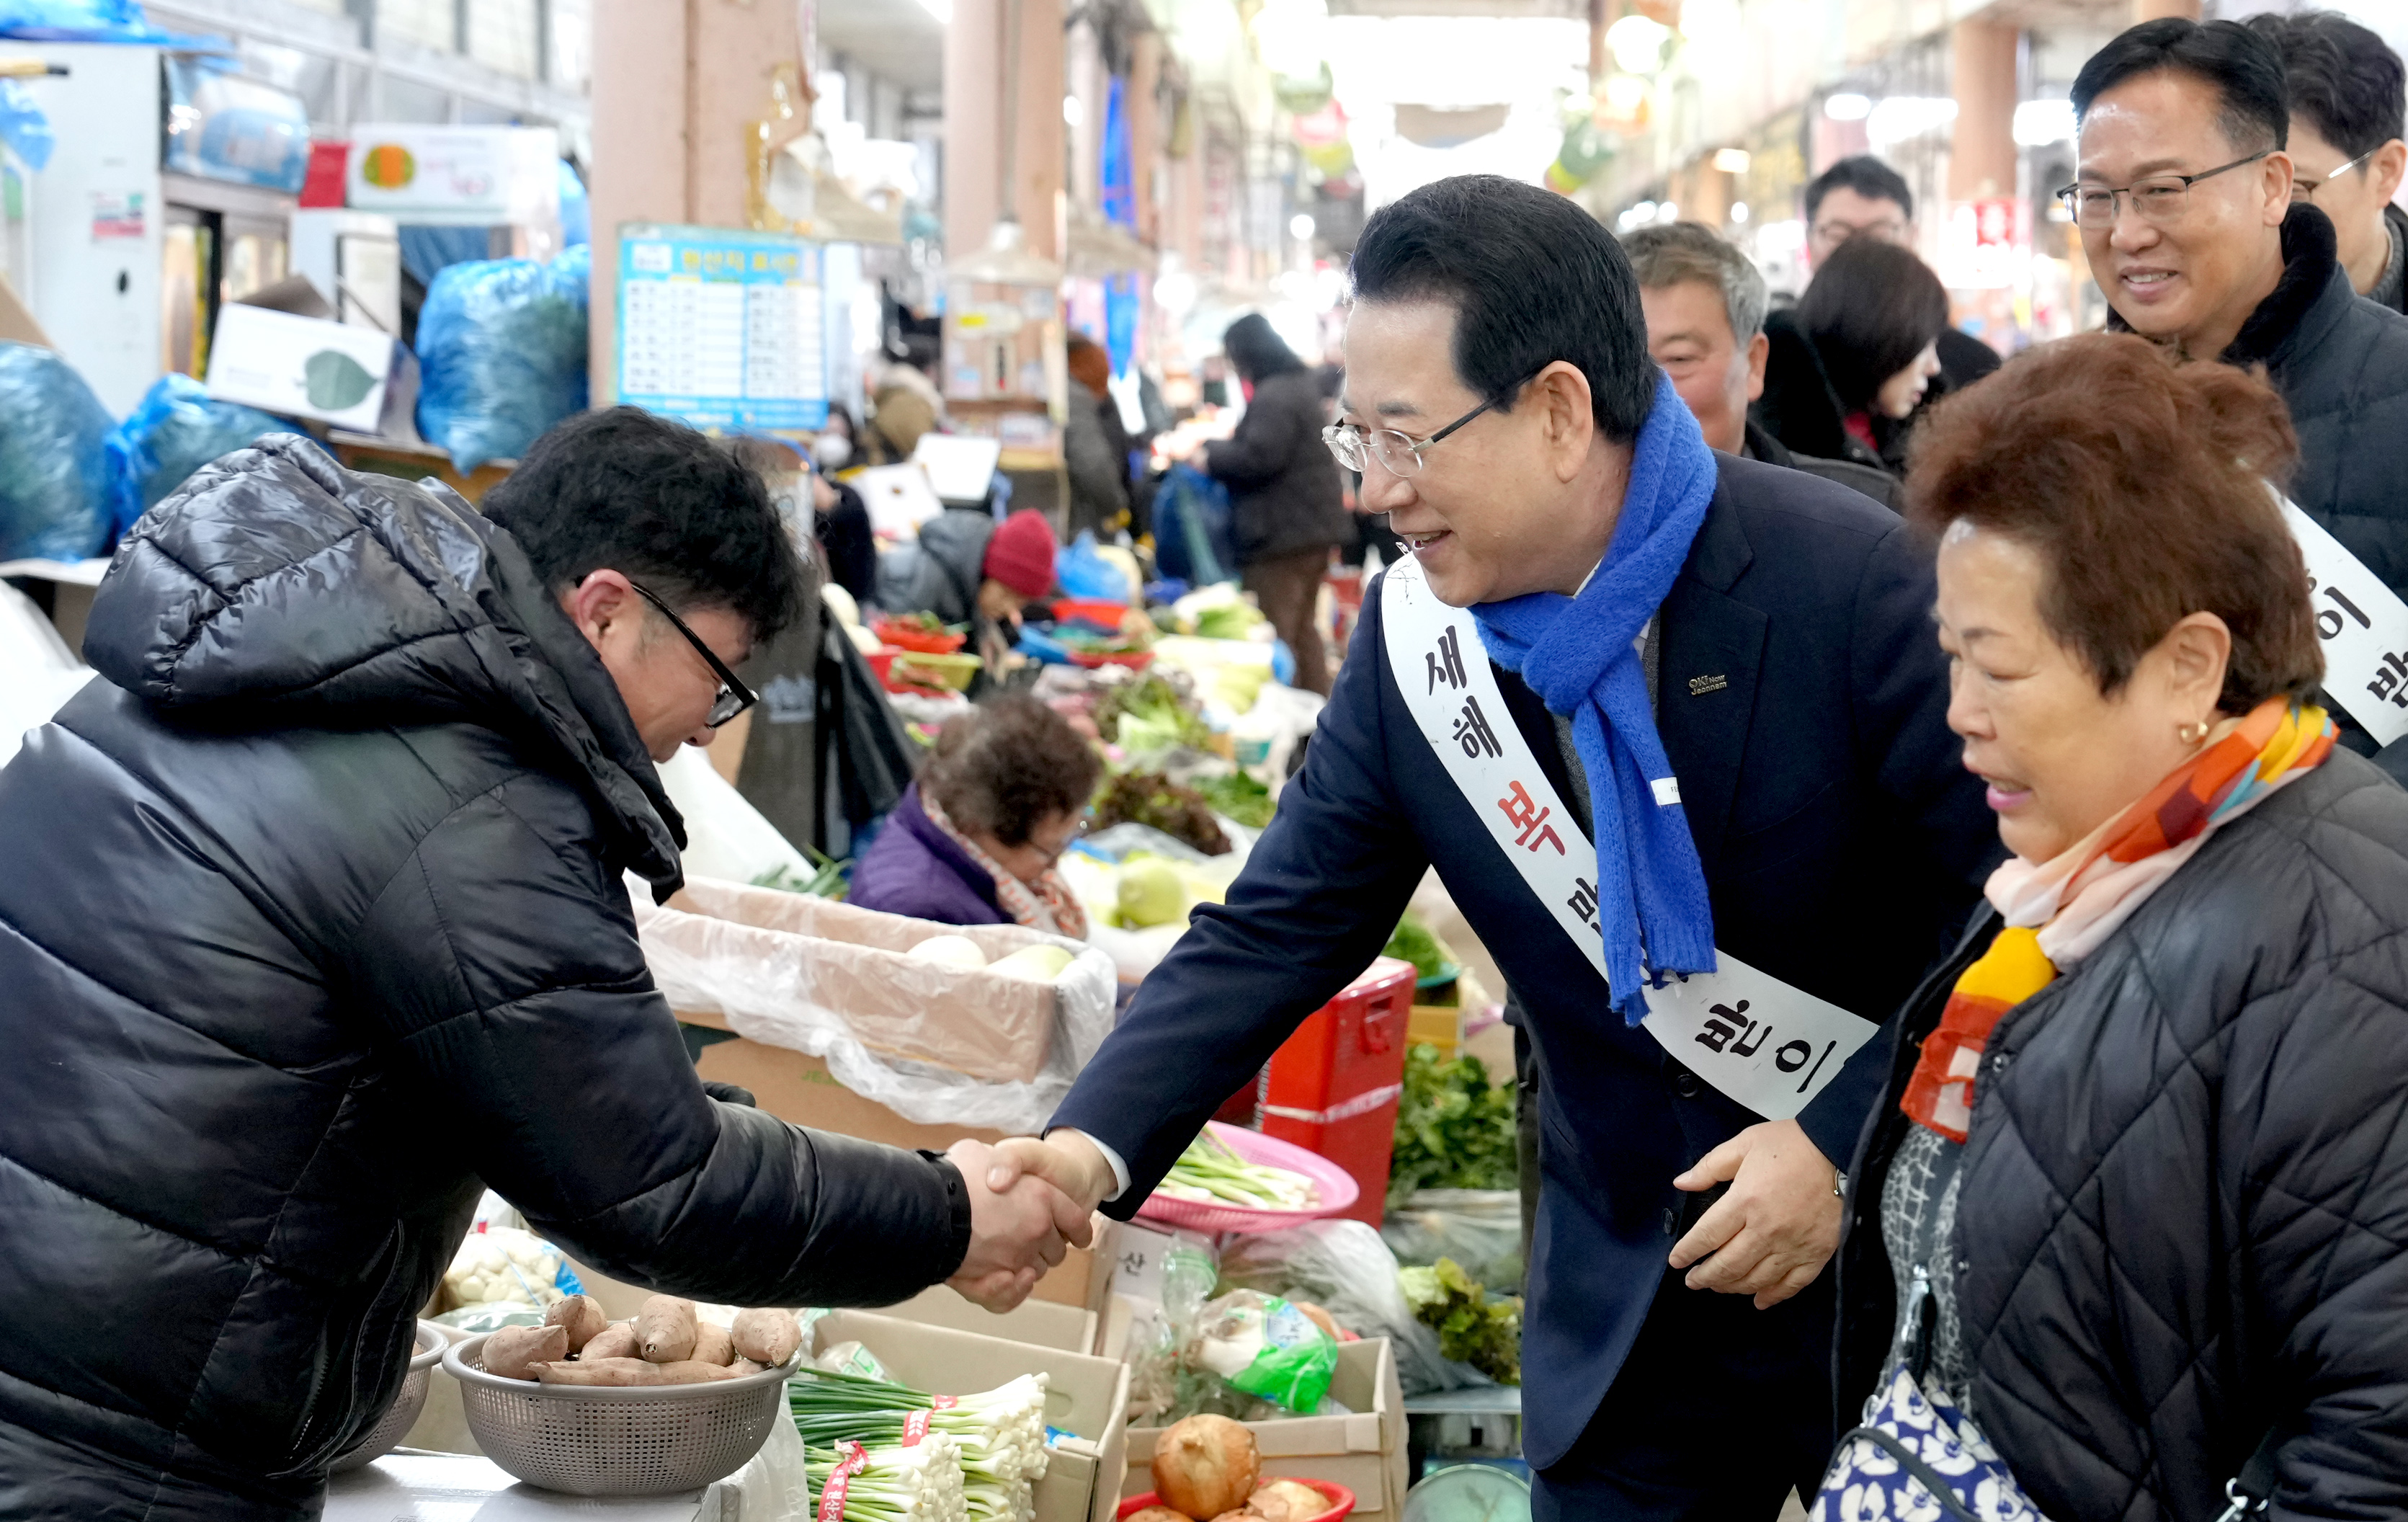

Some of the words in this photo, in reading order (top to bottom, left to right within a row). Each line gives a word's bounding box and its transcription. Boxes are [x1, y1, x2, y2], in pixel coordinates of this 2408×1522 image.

[1708, 674, 1726, 685] Now
[1690, 680, 1728, 696] Jeonnam
[1424, 624, 1503, 760] 새해
[1497, 780, 1566, 856] 복
